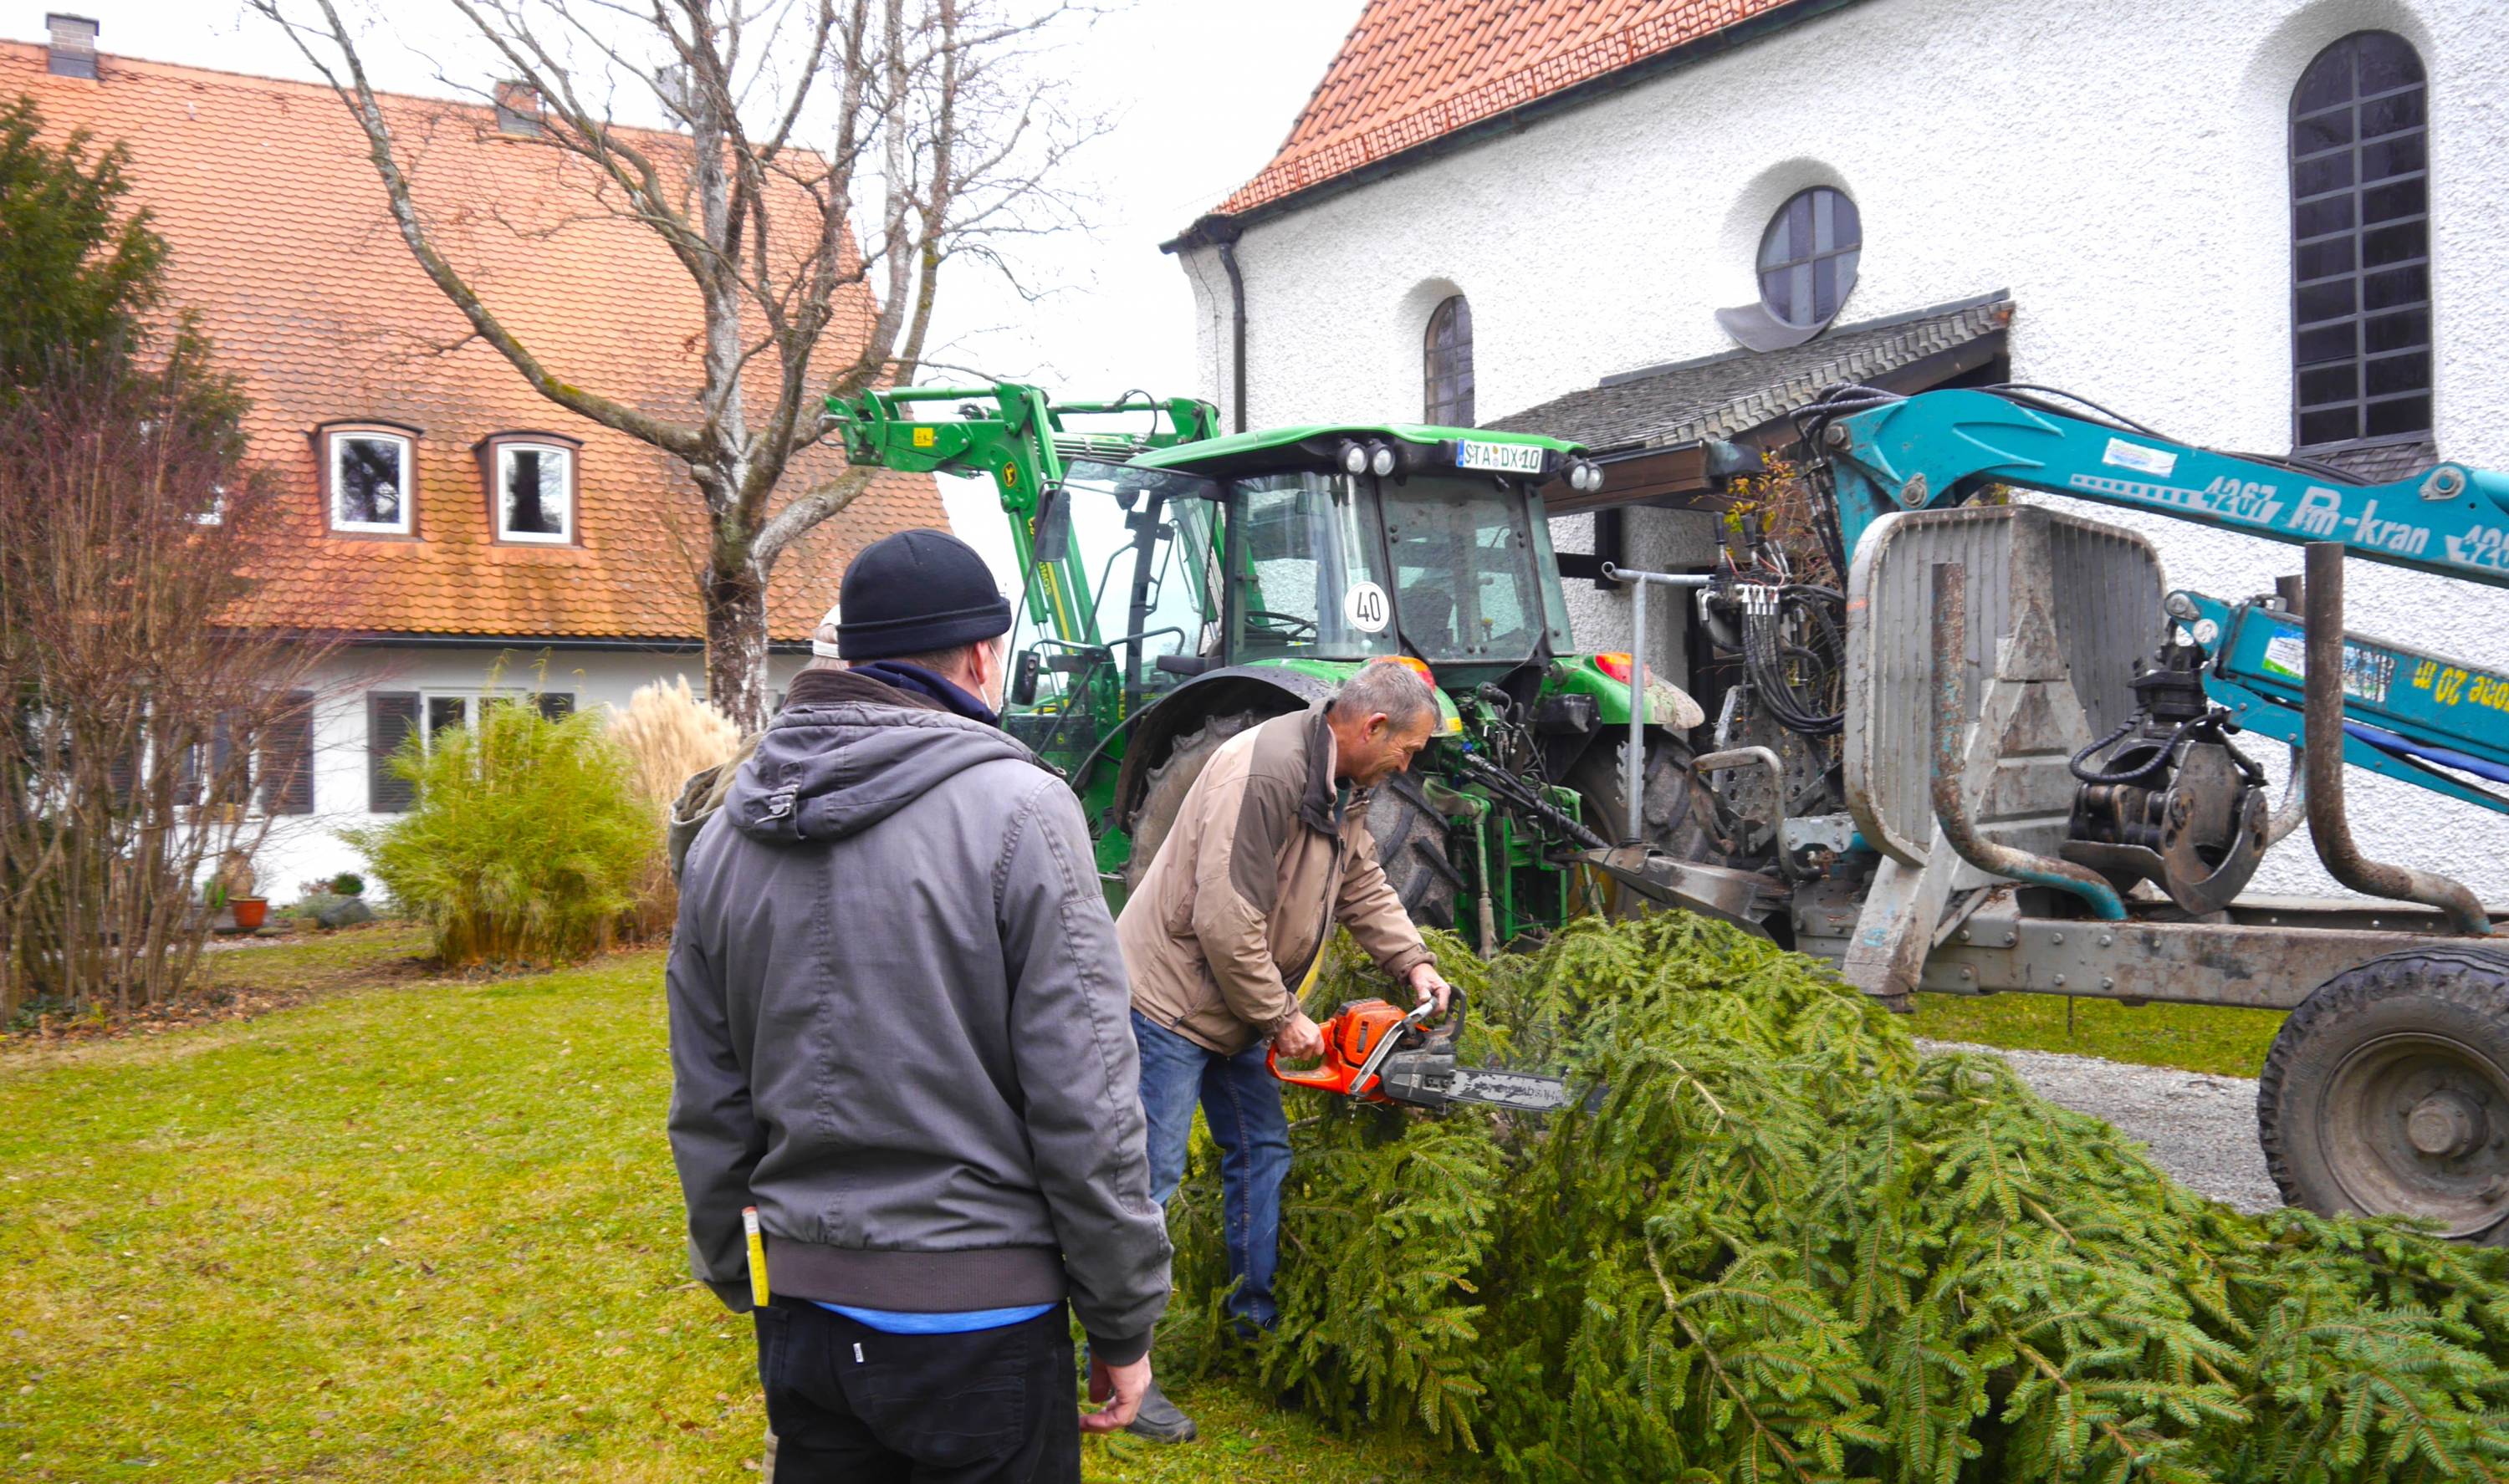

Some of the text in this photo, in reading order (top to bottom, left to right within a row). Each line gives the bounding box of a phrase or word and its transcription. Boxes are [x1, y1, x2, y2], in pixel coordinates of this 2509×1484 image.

[1464, 443, 1491, 466] STA
[2202, 474, 2278, 518] 4267
[1357, 591, 1381, 622] 40
[2412, 660, 2438, 691] m
[2435, 666, 2469, 706] 20
